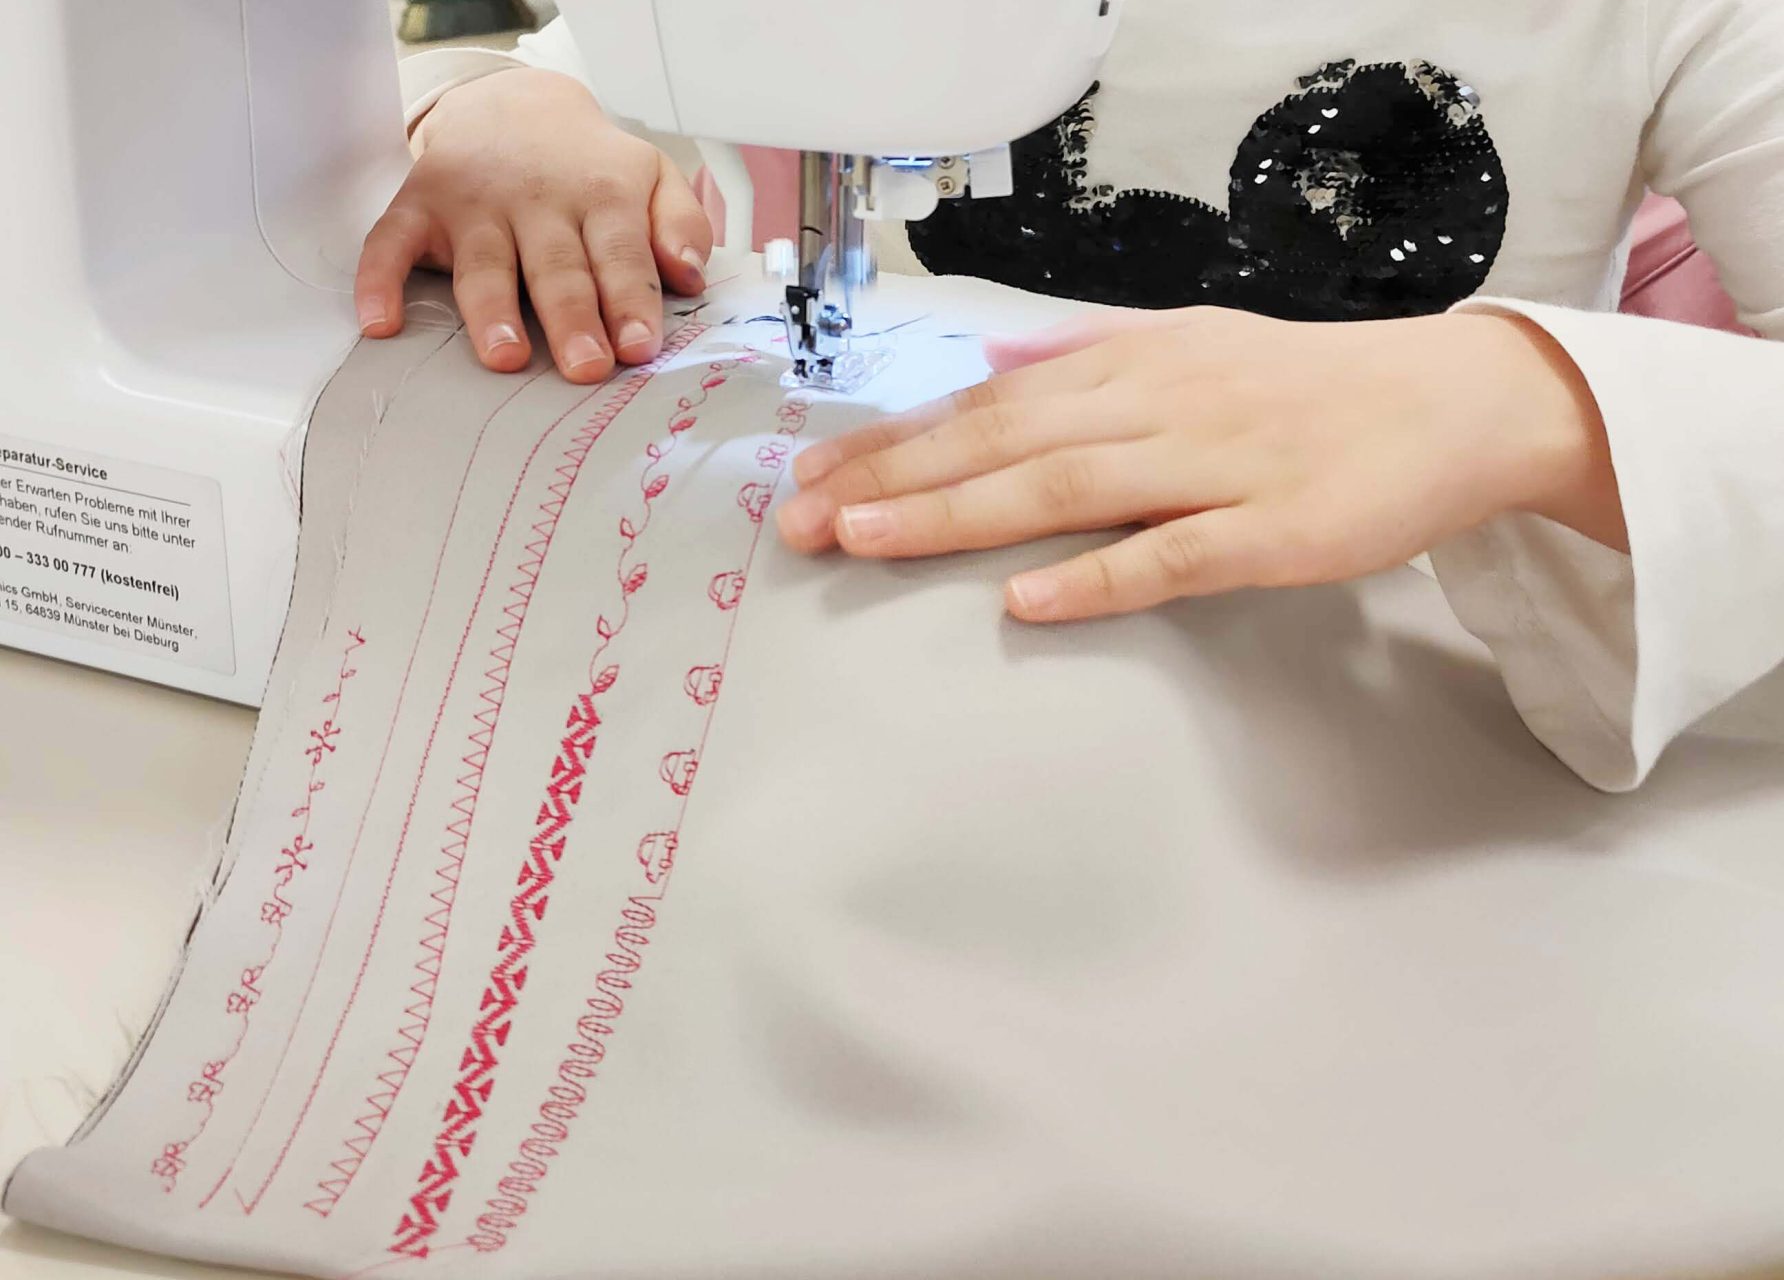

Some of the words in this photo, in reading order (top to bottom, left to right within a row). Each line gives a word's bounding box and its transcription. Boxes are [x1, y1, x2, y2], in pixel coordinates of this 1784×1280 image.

[16, 478, 71, 503] Erwarten
[75, 491, 135, 517] Probleme
[138, 507, 157, 522] mit
[161, 509, 191, 528] Ihrer
[36, 520, 108, 549] Rufnummer
[45, 506, 77, 523] rufen
[81, 511, 101, 528] Sie
[105, 520, 129, 534] uns
[132, 522, 159, 541] bitte
[162, 533, 196, 549] unter
[26, 551, 50, 568] 333
[53, 557, 69, 573] 00
[72, 561, 96, 579] 777
[101, 568, 179, 602] (kostenfrei)
[21, 586, 63, 607] GmbH,
[65, 596, 143, 625] Servicecenter
[25, 603, 61, 622] 64839
[64, 612, 110, 633] Münster
[113, 623, 131, 639] bei
[134, 628, 180, 653] Dieburg
